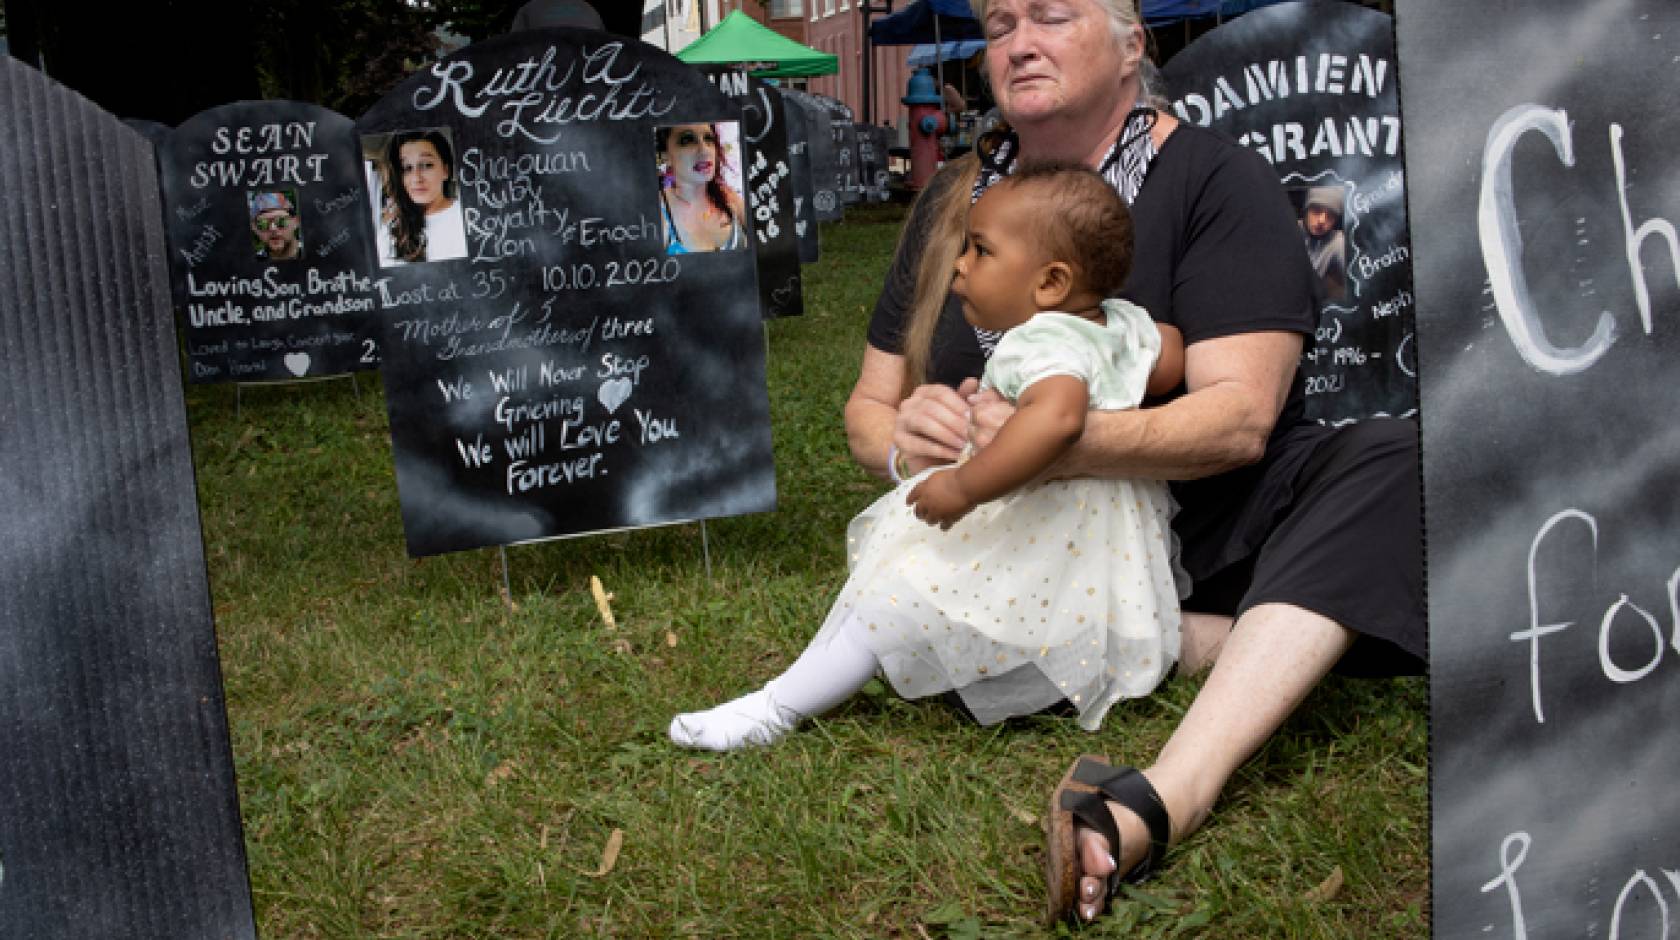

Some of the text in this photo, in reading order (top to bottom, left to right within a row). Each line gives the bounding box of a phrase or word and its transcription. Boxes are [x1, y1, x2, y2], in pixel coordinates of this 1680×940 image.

[413, 41, 642, 118] Ruth A
[1173, 52, 1387, 128] DAMIEN
[212, 122, 316, 154] SEAN
[190, 153, 329, 188] SWART
[475, 175, 542, 209] Ruby
[464, 198, 569, 242] Royalty
[579, 214, 658, 247] Enoch
[188, 274, 262, 297] Loving
[376, 276, 433, 309] Lost
[252, 302, 285, 321] and
[288, 294, 375, 320] Grandson
[393, 310, 484, 346] Mother
[359, 339, 382, 363] 2
[437, 351, 650, 402] We Will Never Stop
[495, 395, 583, 432] Grieving
[456, 433, 492, 469] We
[560, 417, 621, 449] Love
[634, 407, 679, 446] You
[506, 451, 608, 496] Forever.
